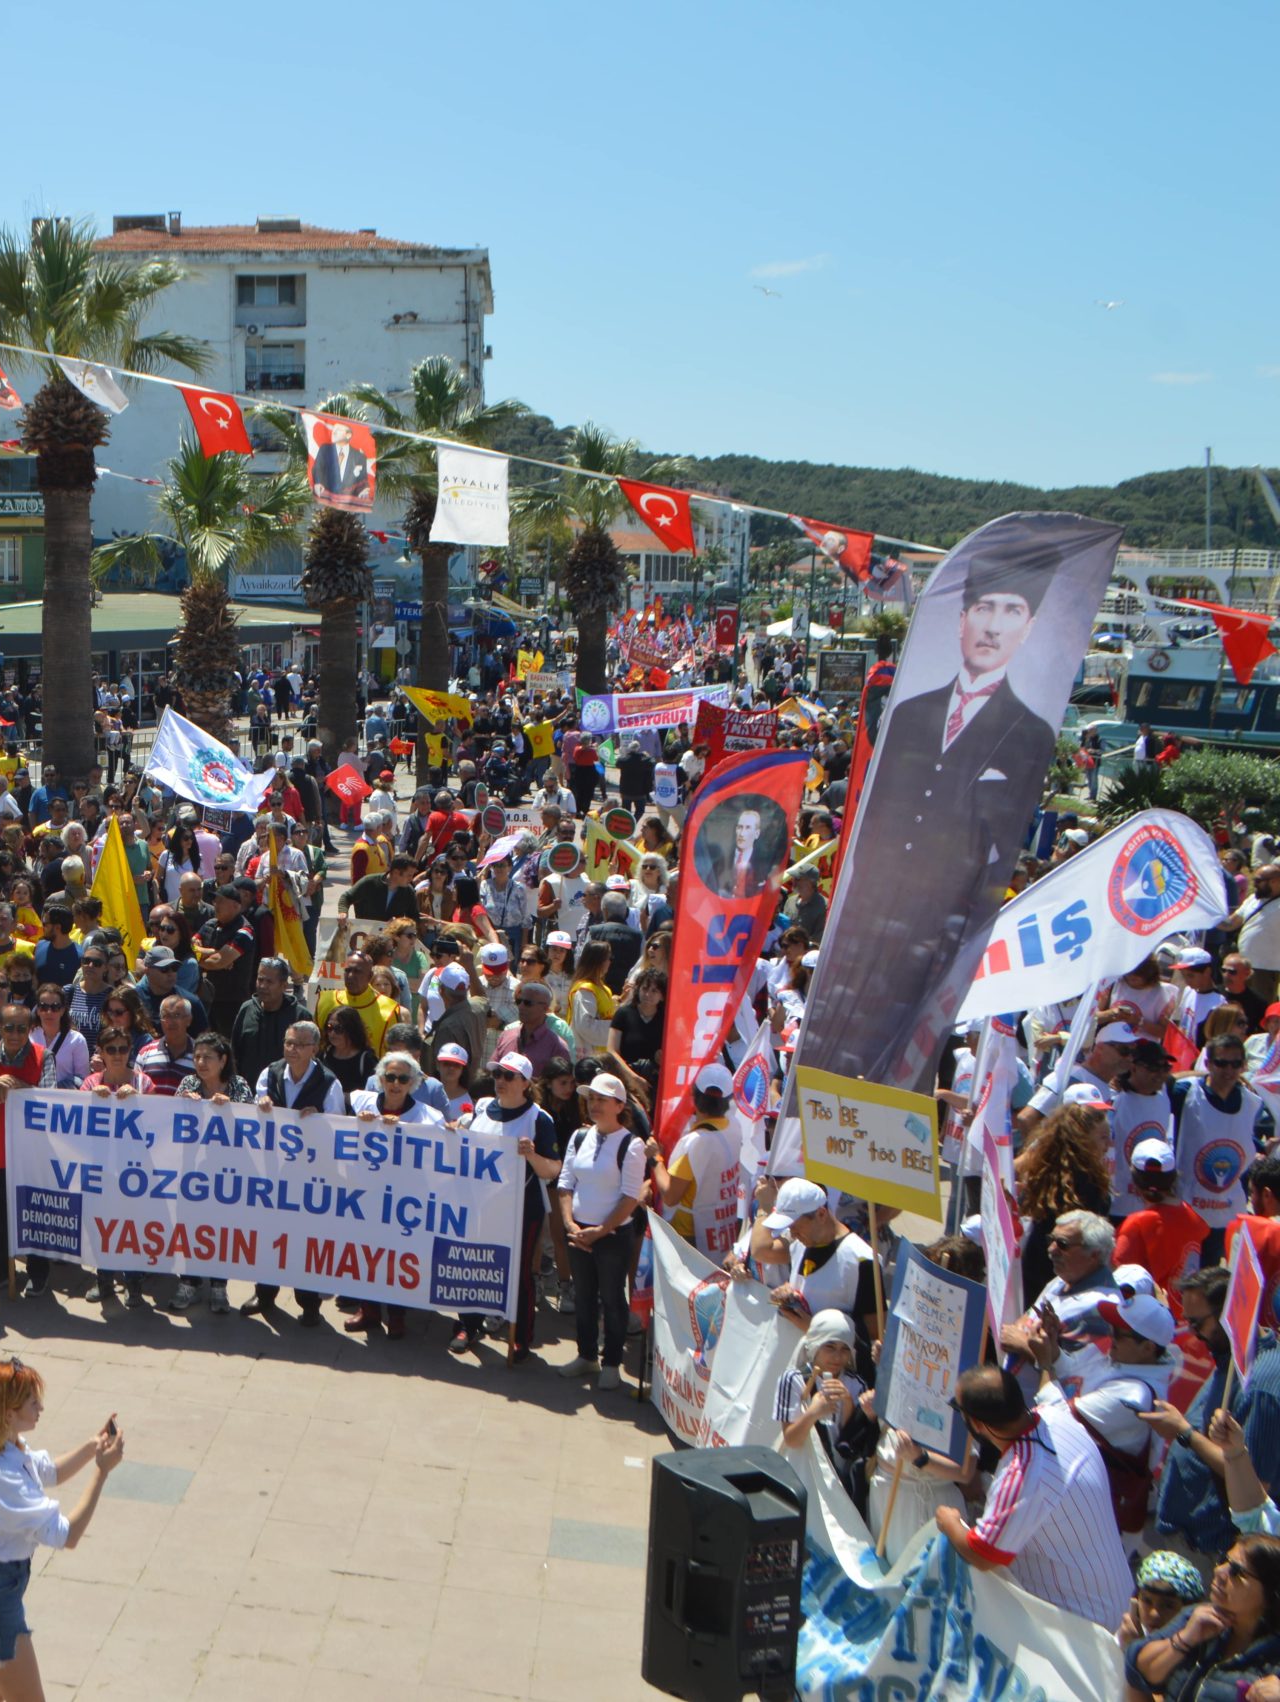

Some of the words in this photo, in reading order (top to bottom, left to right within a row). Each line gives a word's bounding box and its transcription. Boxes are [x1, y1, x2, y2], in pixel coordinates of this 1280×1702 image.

[443, 475, 500, 491] AYVALIK
[731, 723, 772, 737] MAYIS
[336, 783, 352, 796] CHP
[839, 1105, 860, 1128] BE
[24, 1100, 155, 1149] EMEK,
[172, 1112, 316, 1164] BARIŞ,
[333, 1126, 505, 1184] EŞİTLİK
[852, 1128, 868, 1140] or
[826, 1135, 856, 1159] NOT
[31, 1191, 70, 1210] AYVALIK
[50, 1159, 103, 1194] VE
[118, 1161, 368, 1221] ÖZGÜRLÜK
[381, 1184, 468, 1238] İÇİN
[22, 1231, 79, 1251] PLATFORMU
[94, 1216, 258, 1266] YAŞASIN
[272, 1233, 288, 1270] 1
[304, 1236, 421, 1291] MAYIS
[448, 1245, 495, 1263] AYVALIK
[436, 1284, 504, 1305] PLATFORMU
